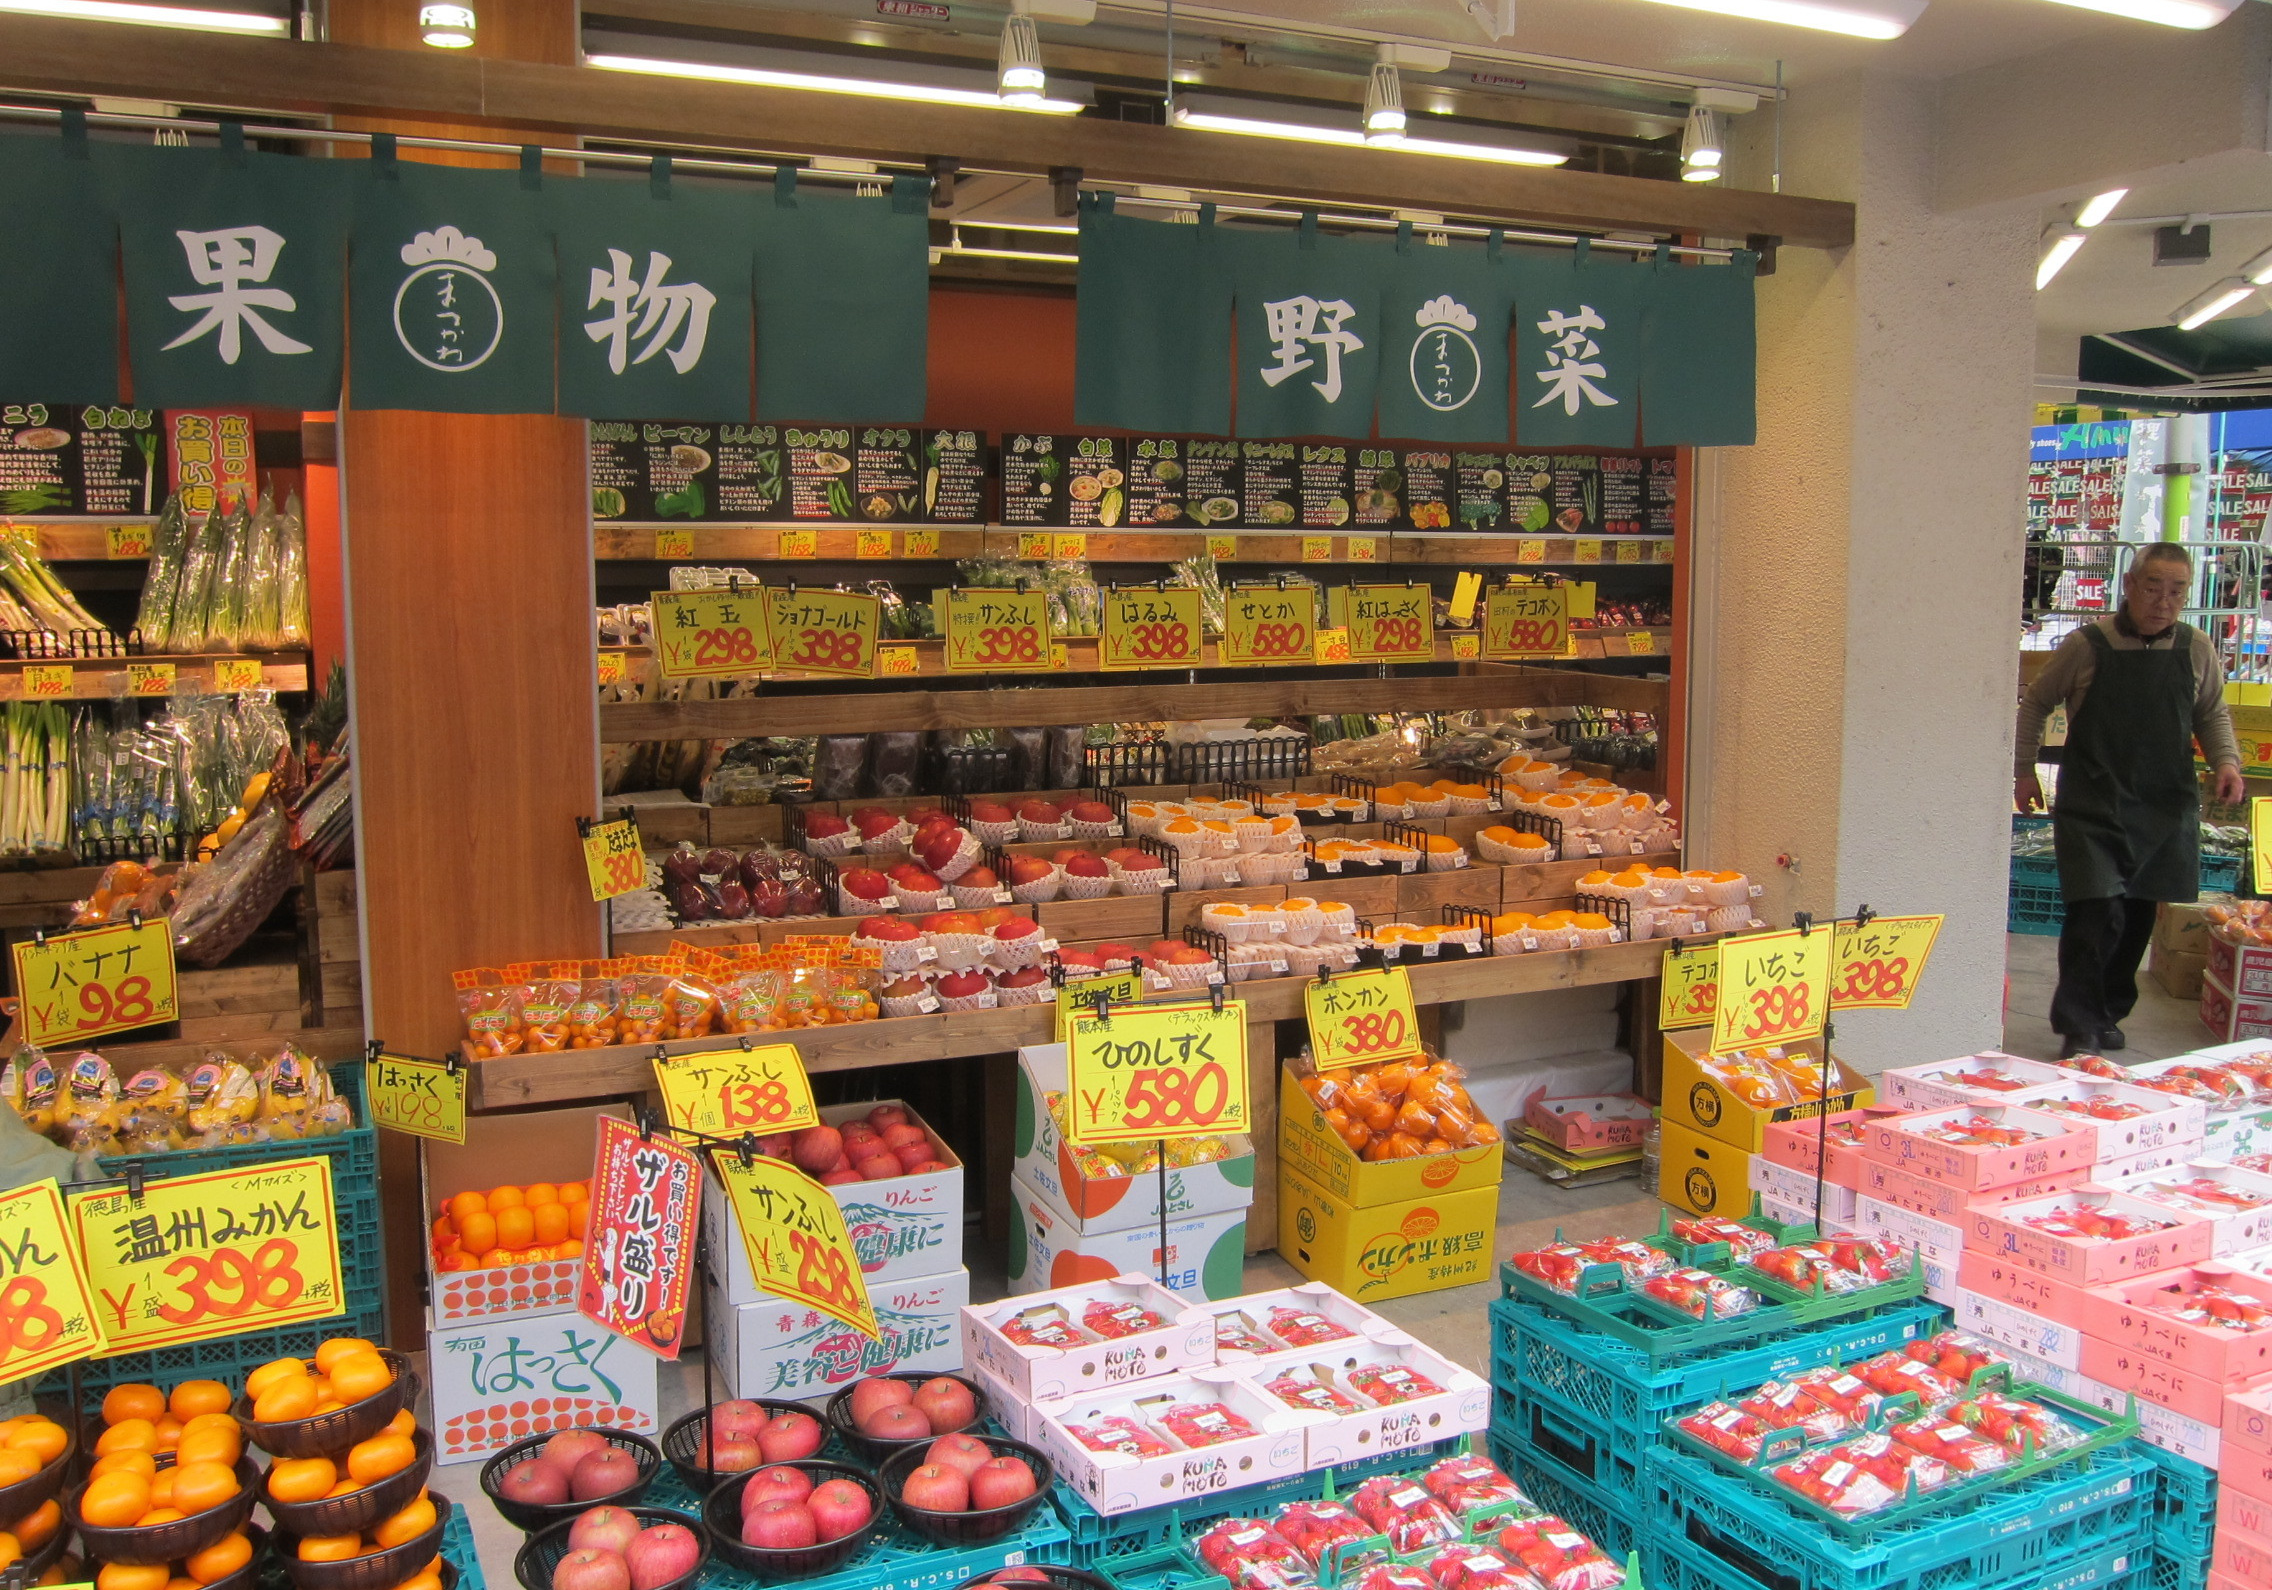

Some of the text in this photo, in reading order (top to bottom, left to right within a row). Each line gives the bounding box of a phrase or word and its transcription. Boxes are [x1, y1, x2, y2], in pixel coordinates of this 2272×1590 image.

[160, 224, 717, 376] 果 物
[435, 271, 464, 364] まつかわ
[1260, 294, 1619, 417] 野 菜
[1434, 331, 1453, 404] まつかわ
[3, 403, 49, 427] ニラ
[82, 405, 152, 430] 白ねぎ
[217, 415, 249, 475] 本日の
[643, 423, 711, 444] ピーマン
[719, 424, 777, 445] ししとう
[785, 428, 850, 448] きゅうり
[862, 427, 911, 447] オクラ
[933, 430, 978, 450] 大根
[1013, 434, 1053, 454] かぶ
[2036, 438, 2056, 449] shoes
[1078, 437, 1114, 458] 白菜
[1137, 439, 1178, 458] 水菜
[1187, 440, 1239, 459] チンゲン菜
[1243, 440, 1295, 459] サニーレタス
[1303, 446, 1347, 463] レタス
[1455, 451, 1502, 468] ブロッコリー
[176, 414, 217, 513] お買い得
[1405, 451, 1451, 469] パプリカ
[1506, 453, 1550, 472] キャベツ
[2050, 478, 2080, 495] SALE
[2048, 503, 2078, 519] SALE
[911, 536, 933, 544] オクラ
[1063, 546, 1080, 557] 100
[2076, 585, 2103, 601] SALE
[675, 604, 741, 629] 紅玉
[776, 604, 867, 631] ジョナゴールド
[979, 603, 1037, 625] サンふじ
[1121, 601, 1179, 623] はるみ
[1240, 602, 1296, 620] せとか
[1356, 599, 1421, 620] 紅はっさく
[693, 626, 760, 666] 298
[974, 625, 1040, 664] 398
[1130, 622, 1190, 660] 398
[1251, 622, 1306, 657] 580
[1373, 617, 1423, 653] 298
[1508, 618, 1560, 651] 580
[791, 628, 863, 669] 398
[602, 849, 643, 895] 380
[1842, 932, 1907, 959] いちご
[50, 943, 142, 990] バナナ
[1745, 945, 1811, 987] いちご
[1831, 956, 1910, 1000] 398
[33, 975, 155, 1033] ¥ 98
[1323, 985, 1389, 1016] ポンカン
[1724, 980, 1810, 1040] ¥ 398
[1075, 1018, 1115, 1035] 熊本産
[1341, 1009, 1406, 1055] 380
[1091, 1025, 1216, 1069] ひのしずく
[377, 1062, 438, 1098] はっさく
[686, 1058, 790, 1089] サンふじ
[675, 1081, 793, 1131] ¥ 138
[1081, 1060, 1230, 1128] ¥ 580
[394, 1091, 443, 1129] 198
[699, 1092, 716, 1127] 1個
[1607, 1126, 1632, 1136] KUMA
[1607, 1134, 1632, 1143] MOTO
[2138, 1120, 2164, 1135] KUMA
[2138, 1133, 2164, 1148] MOTO
[2023, 1161, 2048, 1176] MOTO
[2025, 1149, 2049, 1164] KUMA
[84, 1196, 148, 1218] 徳島産
[883, 1186, 939, 1208] りんご
[1885, 1192, 1938, 1217] JAたまな
[750, 1184, 838, 1244] サンふじ
[112, 1190, 323, 1266] 温州みかん
[620, 1147, 670, 1320] ザル盛り
[659, 1158, 689, 1310] お買い得です!
[1357, 1230, 1484, 1273] 高級ポンカン
[1878, 1229, 1939, 1256] JAたまな
[2003, 1231, 2020, 1254] 3L
[2134, 1245, 2160, 1259] KUMA
[788, 1228, 861, 1315] 298
[1427, 1258, 1478, 1281] 紀州特産
[2133, 1257, 2160, 1270] MOTO
[99, 1237, 305, 1330] ¥ 398
[142, 1271, 164, 1320] 1盛
[300, 1278, 332, 1300] +税
[1991, 1268, 2051, 1299] ゆうべに
[892, 1288, 945, 1311] りんご
[1973, 1303, 1985, 1318] 秀
[56, 1311, 89, 1338] +税
[775, 1310, 823, 1333] 青森
[2120, 1315, 2187, 1349] ゆうべに
[1980, 1323, 2048, 1357] JAたまな
[470, 1328, 624, 1406] はっさく
[764, 1322, 952, 1395] 美容と健康に
[1104, 1345, 1147, 1366] KUMA
[1103, 1359, 1147, 1383] MOTO
[2117, 1357, 2184, 1393] ゆうべに
[2101, 1397, 2114, 1412] 秀
[1380, 1410, 1422, 1432] KUMA
[1379, 1427, 1422, 1450] MOTO
[1181, 1456, 1228, 1477] KUMA
[1341, 1460, 1360, 1471] 619
[1181, 1470, 1229, 1493] MOTO
